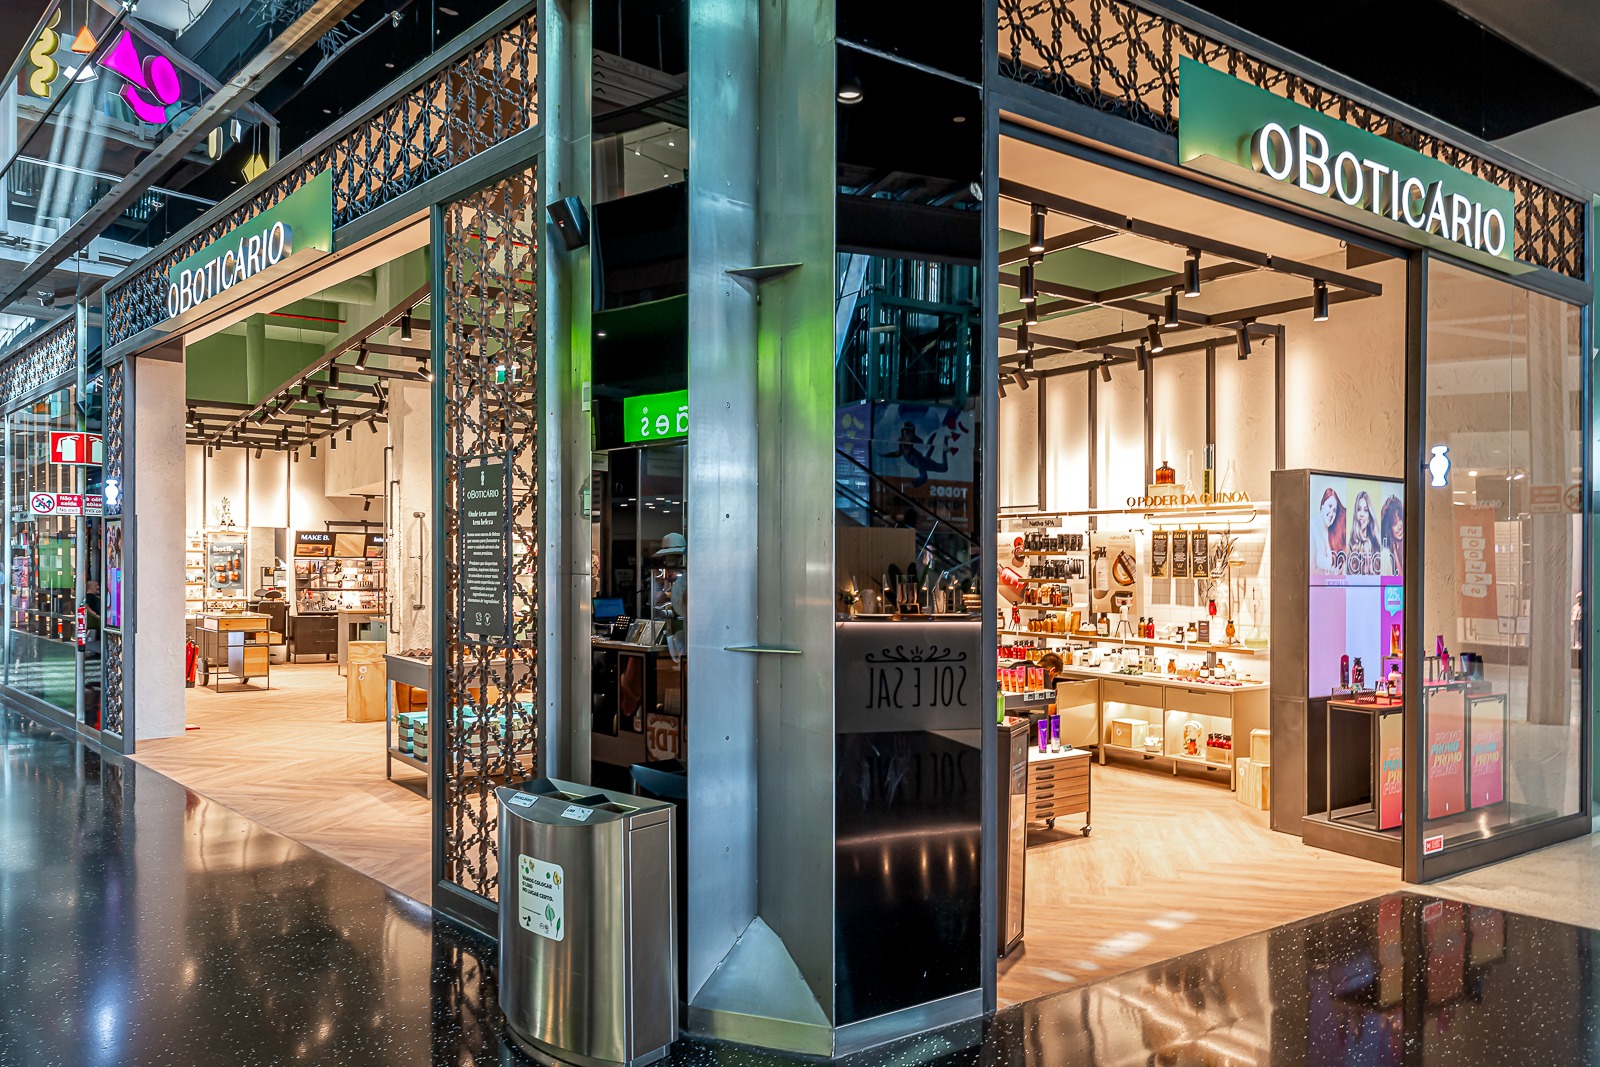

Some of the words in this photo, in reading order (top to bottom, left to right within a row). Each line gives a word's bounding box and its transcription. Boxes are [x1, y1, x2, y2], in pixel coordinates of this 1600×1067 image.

[1126, 496, 1136, 507] O
[1138, 494, 1178, 508] PODER
[1181, 494, 1198, 506] DA
[1200, 491, 1250, 506] QUINOA
[1430, 742, 1459, 756] PROMO
[1433, 752, 1462, 768] PROMO
[1475, 752, 1499, 767] PROMO
[522, 875, 534, 883] VAMOS
[534, 879, 552, 889] COLOCAR
[539, 893, 554, 902] CERTO.
